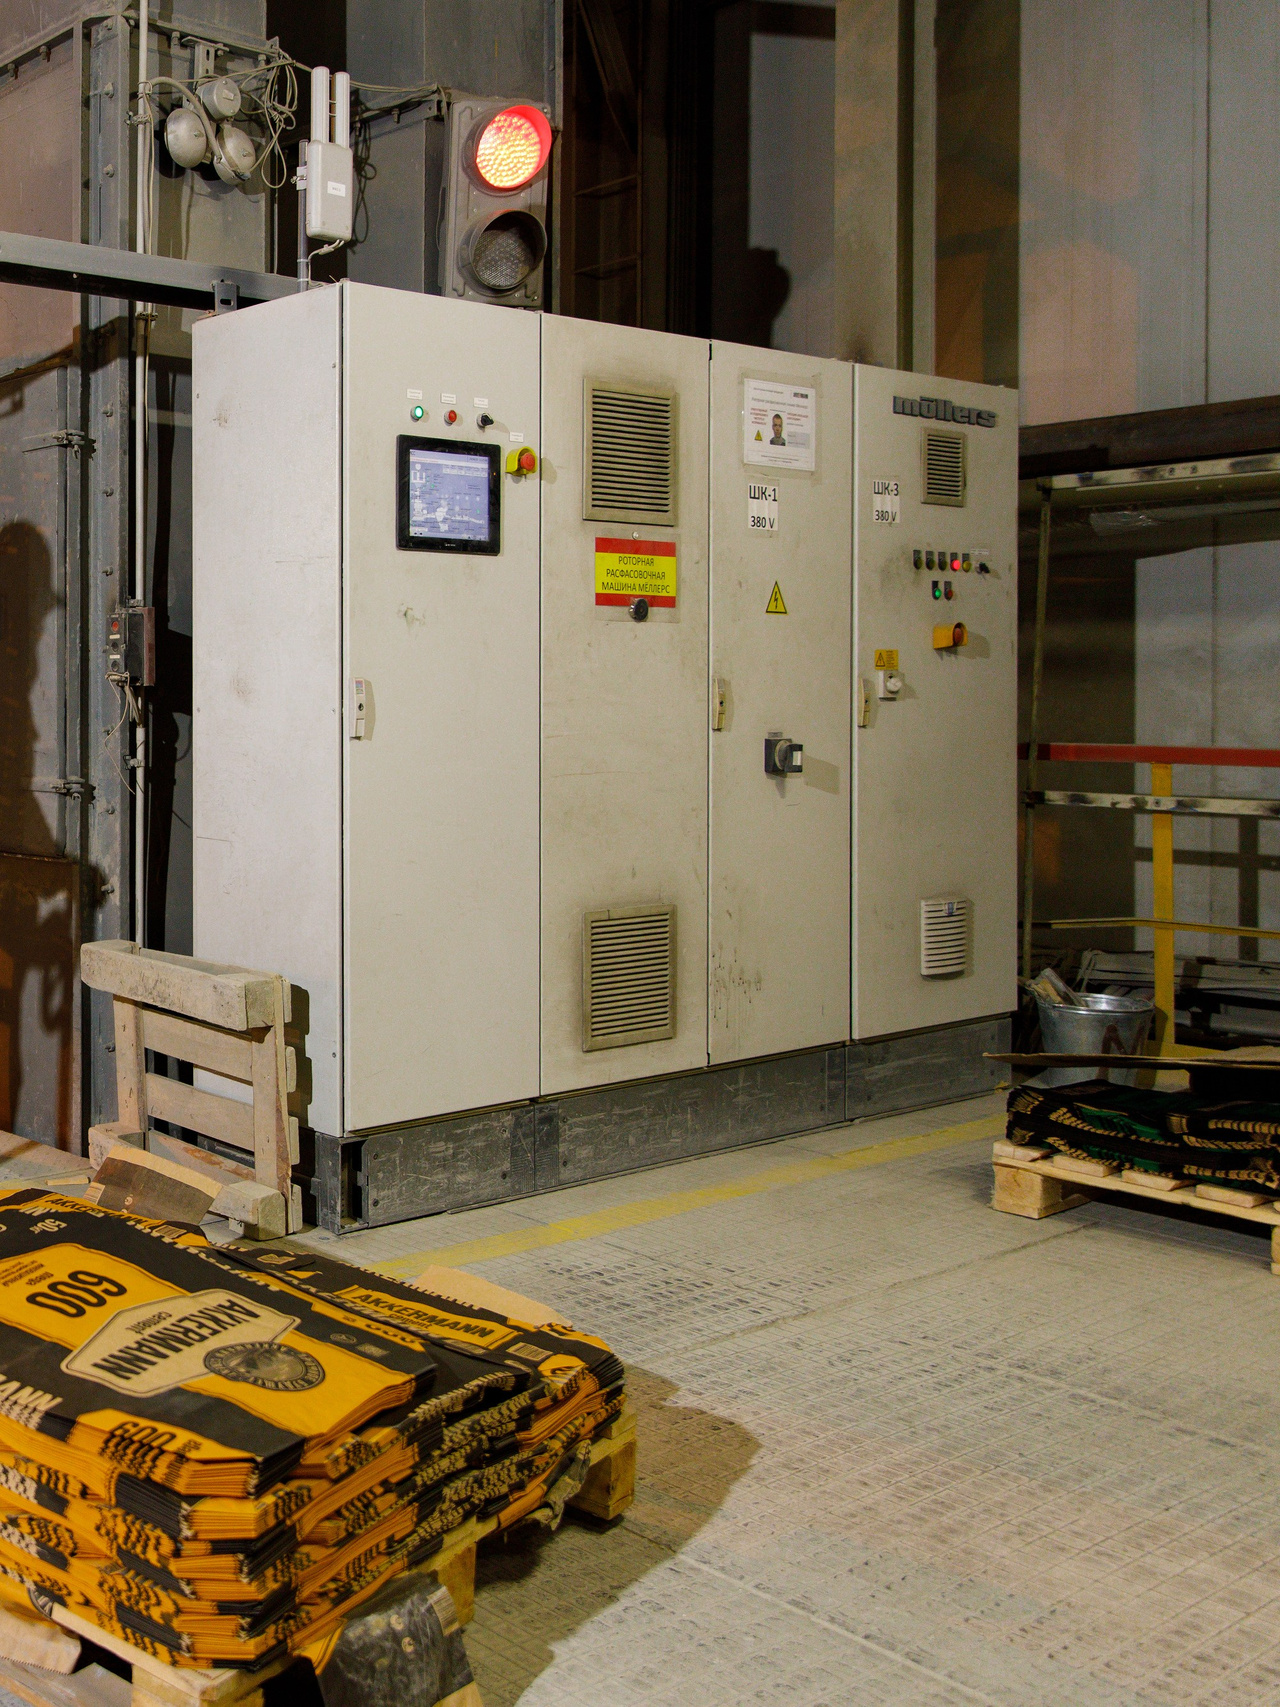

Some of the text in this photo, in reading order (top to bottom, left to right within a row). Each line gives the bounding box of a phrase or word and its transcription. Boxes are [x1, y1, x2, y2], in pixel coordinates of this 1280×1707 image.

[749, 485, 778, 502] ШК-1
[873, 481, 899, 496] ШК-3
[750, 515, 775, 529] 380 V
[874, 509, 890, 521] 380
[618, 555, 655, 566] РОТОРНАЯ
[606, 568, 666, 580] РАСФАСОВОЧНАЯ
[601, 581, 637, 592] МАШИНА
[26, 1270, 128, 1318] 600
[125, 1310, 173, 1334] cement
[352, 1293, 496, 1338] AKKERMANN
[91, 1299, 261, 1381] AKKERMANN
